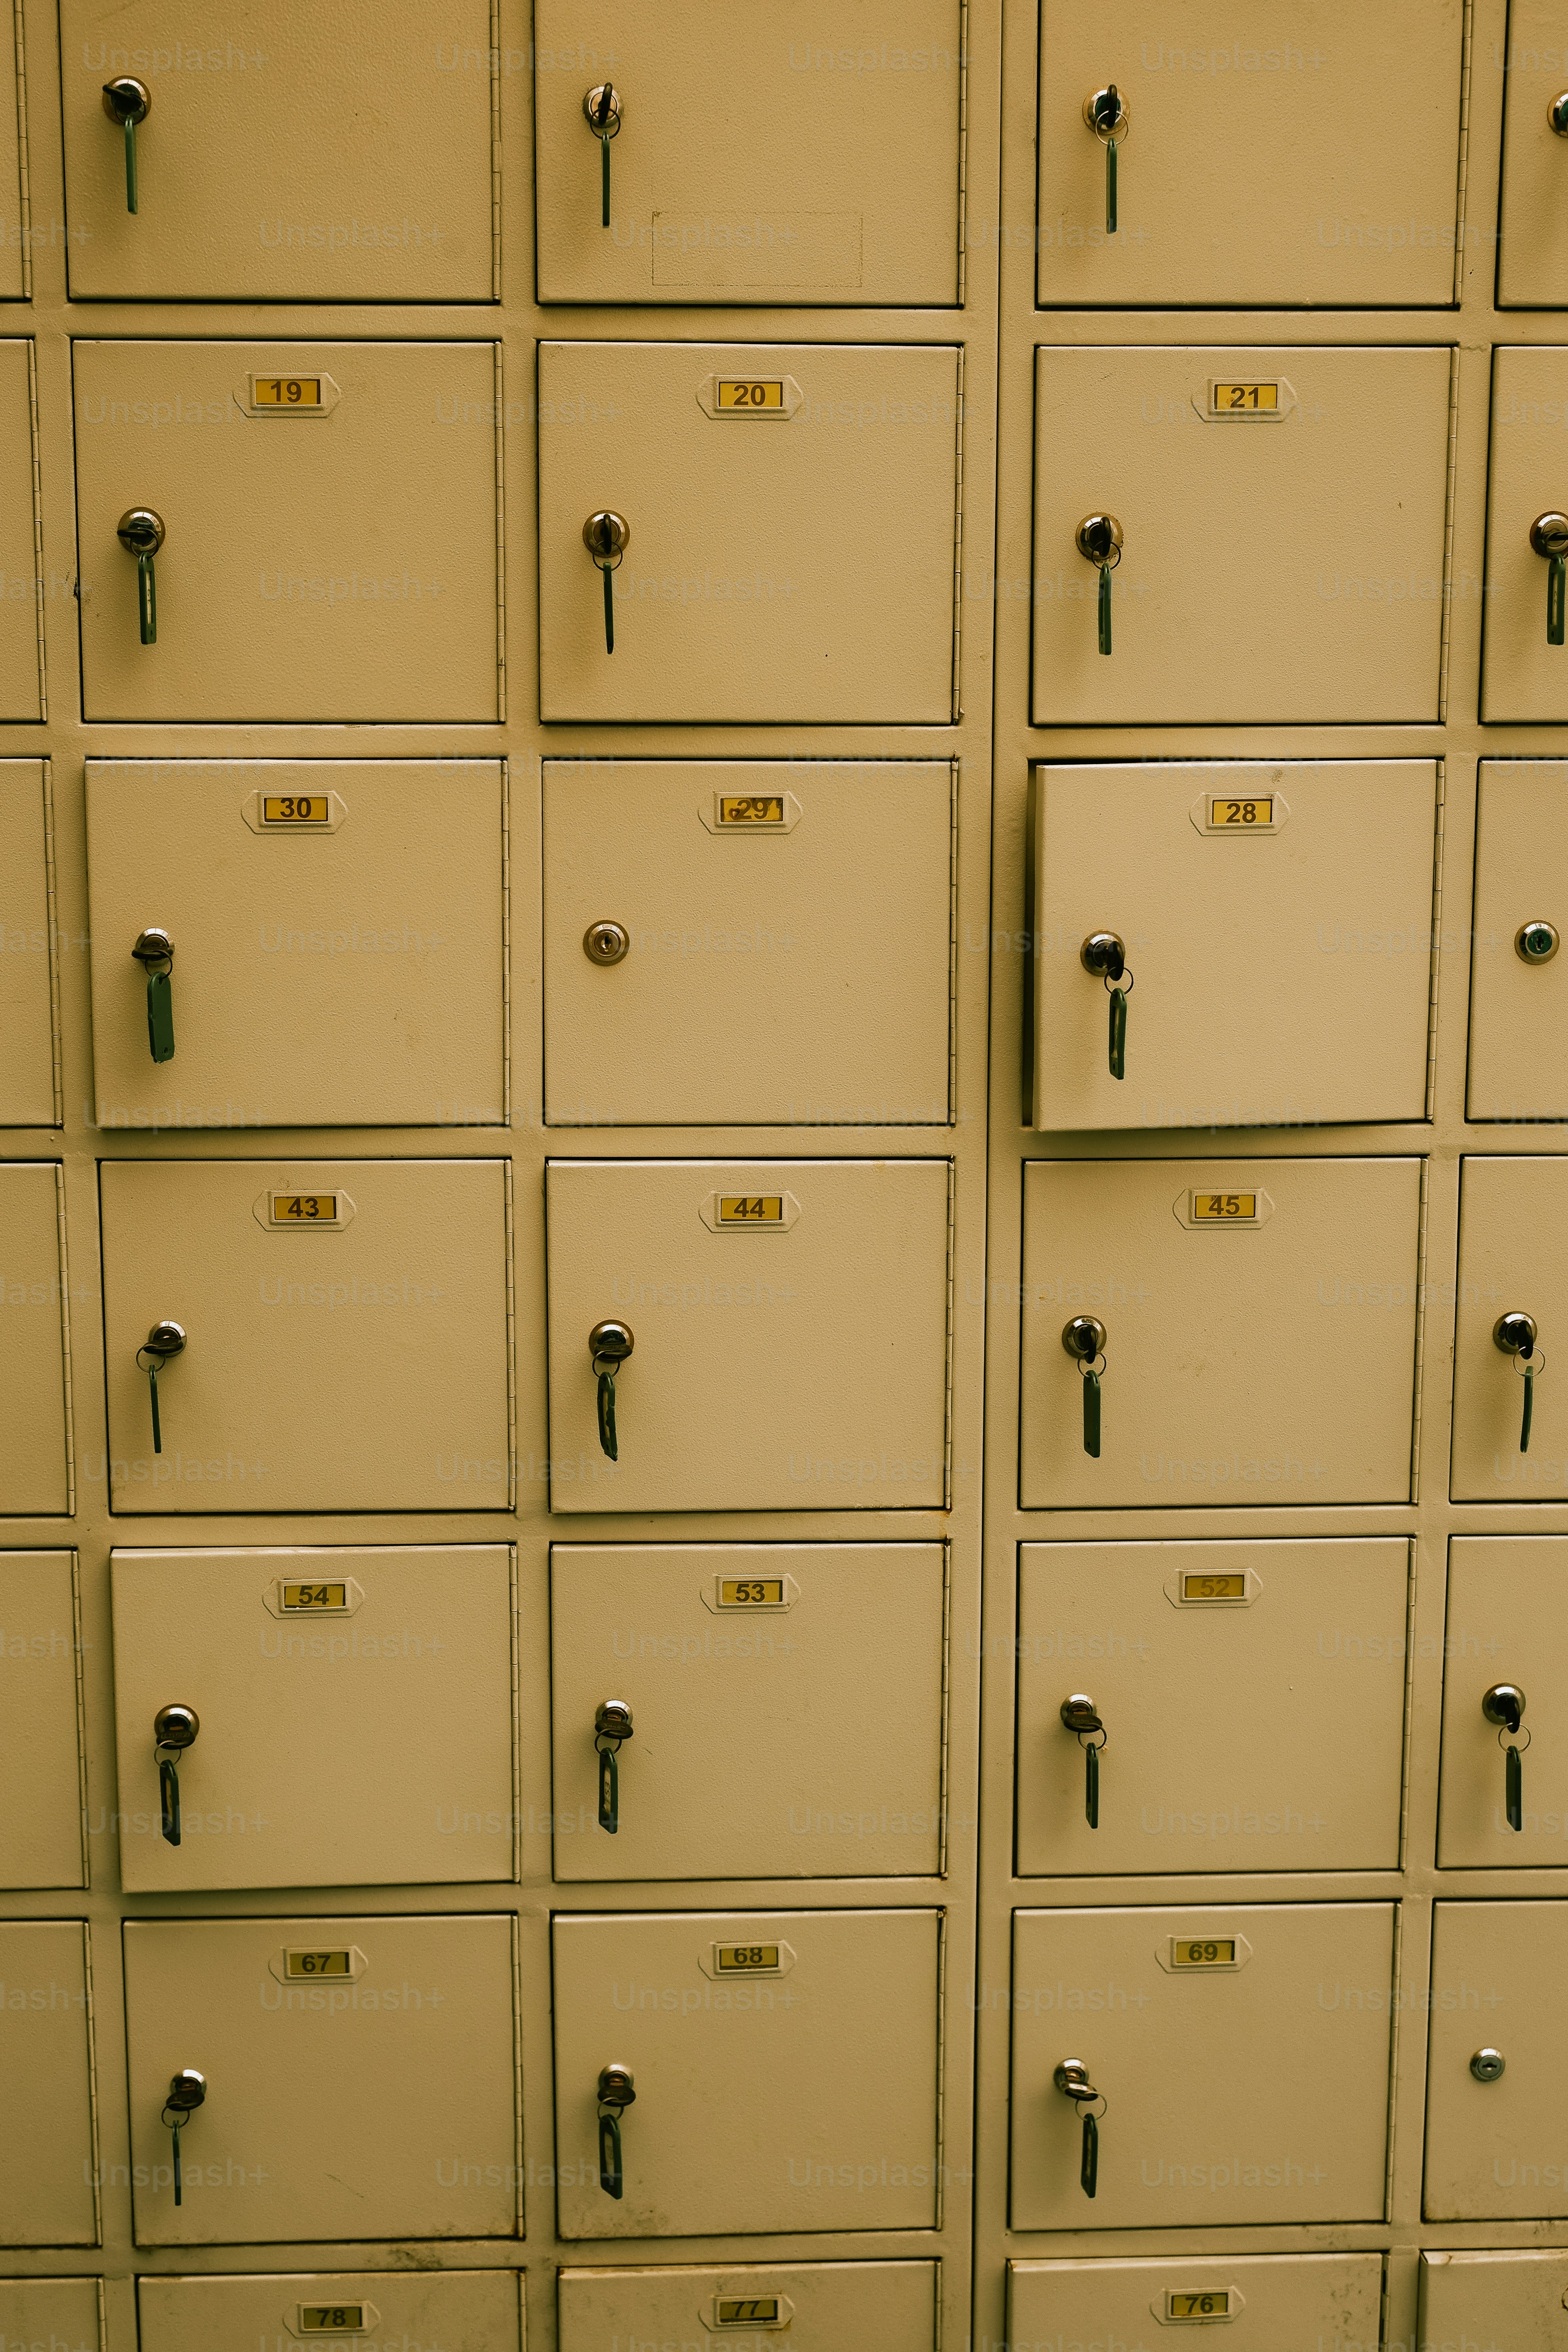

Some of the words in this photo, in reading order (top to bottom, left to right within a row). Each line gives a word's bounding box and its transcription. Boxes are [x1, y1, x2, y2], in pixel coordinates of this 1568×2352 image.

[271, 381, 302, 403] 19
[733, 385, 766, 406] 20
[1230, 387, 1259, 409] 21
[280, 798, 312, 818] 30
[737, 799, 768, 820] 29
[1226, 803, 1256, 823] 28
[288, 1198, 319, 1218] 43
[733, 1198, 766, 1218] 44
[1208, 1196, 1240, 1215] 45
[299, 1586, 329, 1605] 54
[735, 1584, 765, 1602] 53
[1200, 1578, 1230, 1597] 52
[734, 1947, 762, 1964] 68
[1188, 1944, 1217, 1961] 69
[302, 1955, 331, 1972] 67
[731, 2301, 761, 2318] 77
[1184, 2296, 1213, 2314] 76
[316, 2310, 346, 2327] 78
